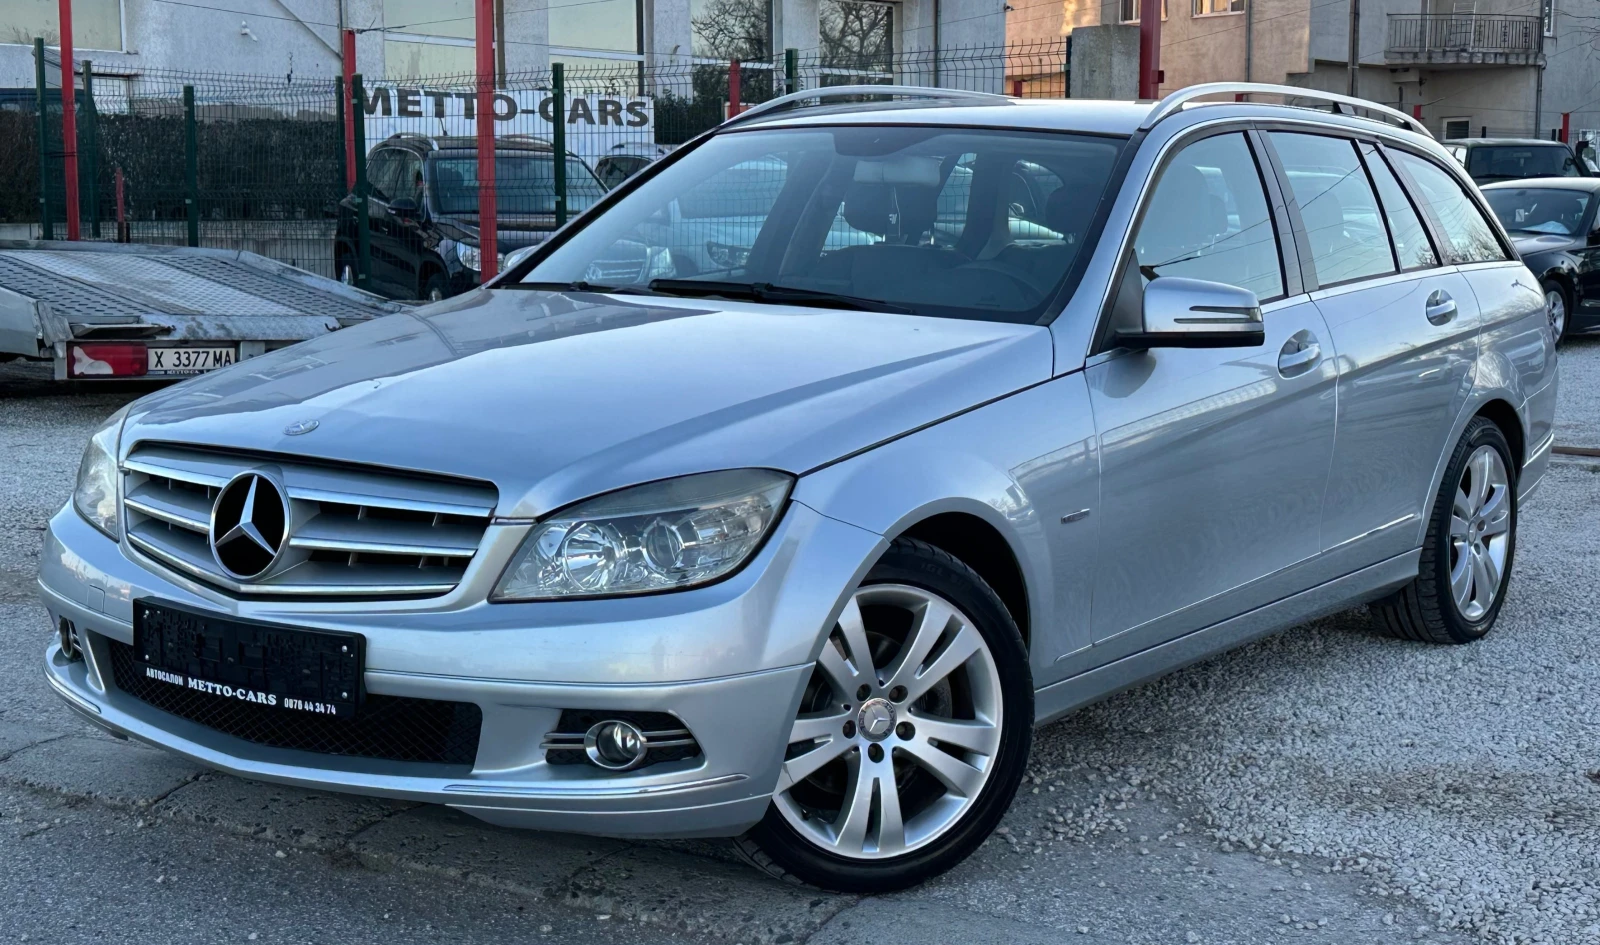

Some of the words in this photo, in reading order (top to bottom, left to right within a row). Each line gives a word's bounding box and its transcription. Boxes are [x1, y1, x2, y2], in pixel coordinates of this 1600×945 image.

[172, 351, 210, 368] 3377
[212, 350, 232, 367] MA
[146, 667, 184, 686] АВТОСАЛОН
[188, 677, 277, 706] METTO-CARS
[304, 701, 314, 712] 44
[315, 702, 325, 714] 34
[326, 704, 336, 715] 74
